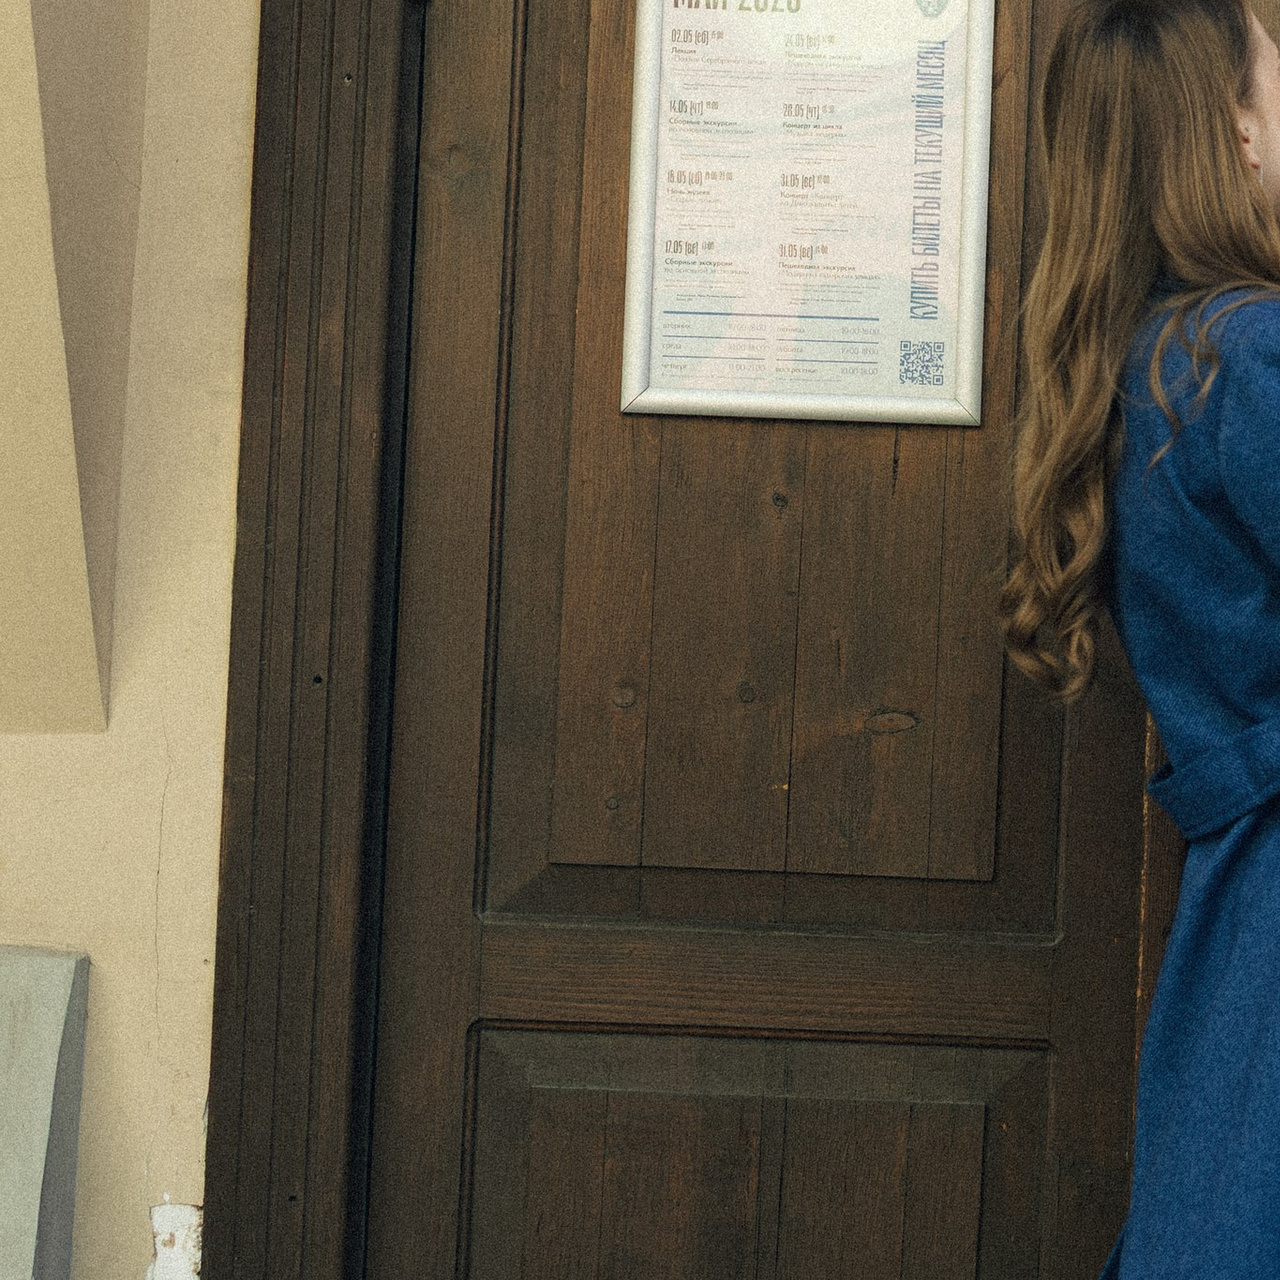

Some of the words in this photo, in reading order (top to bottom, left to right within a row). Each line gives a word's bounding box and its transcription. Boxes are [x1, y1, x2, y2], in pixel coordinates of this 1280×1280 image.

[671, 28, 692, 43] 02.05
[914, 39, 948, 90] МЕСЯЦ
[911, 94, 947, 165] ТЕКУЩИЙ
[913, 170, 943, 191] НА
[911, 195, 942, 257] БИЛЕТЫ
[909, 262, 940, 321] КУПИТЬ
